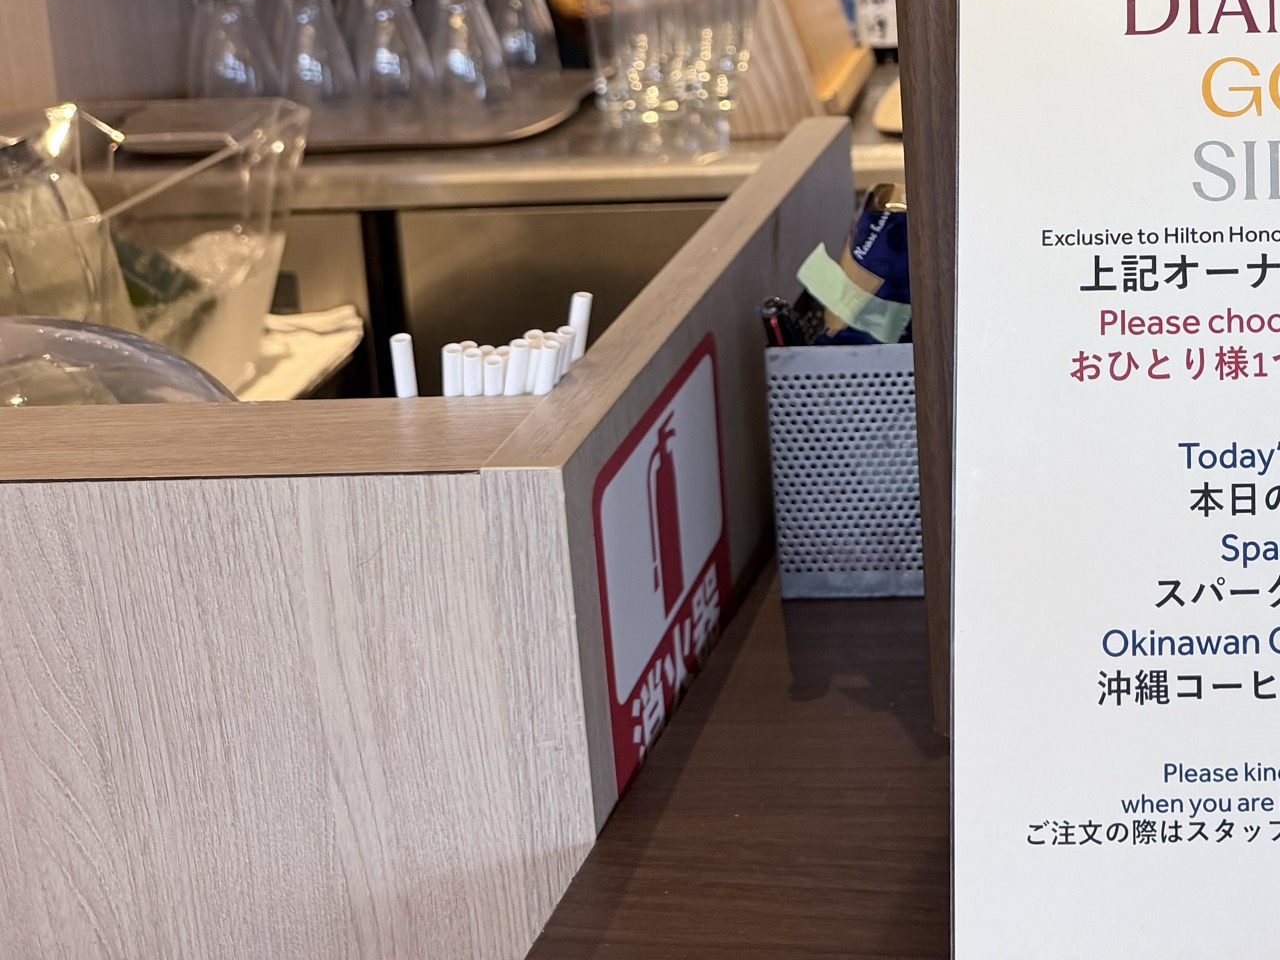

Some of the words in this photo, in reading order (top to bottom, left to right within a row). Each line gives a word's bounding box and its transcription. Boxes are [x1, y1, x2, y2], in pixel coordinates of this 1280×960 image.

[1041, 228, 1134, 247] Exclusive
[1136, 228, 1160, 245] to
[1164, 226, 1225, 245] Hilton
[1100, 309, 1201, 336] Please
[1102, 628, 1260, 658] Okinawan
[1163, 762, 1239, 784] Please
[1120, 793, 1184, 814] when
[1188, 797, 1232, 819] you
[1237, 796, 1275, 813] are
